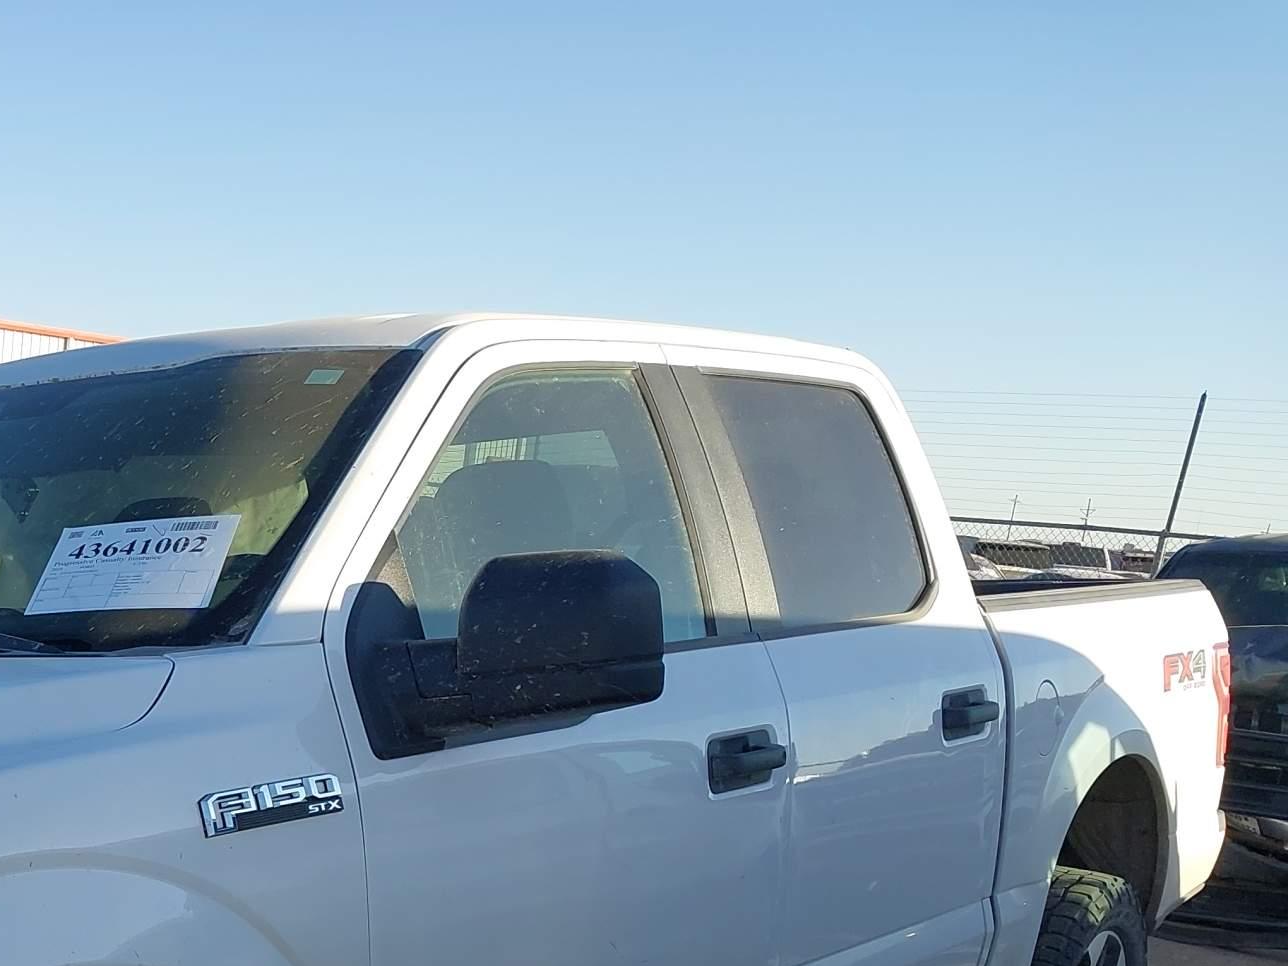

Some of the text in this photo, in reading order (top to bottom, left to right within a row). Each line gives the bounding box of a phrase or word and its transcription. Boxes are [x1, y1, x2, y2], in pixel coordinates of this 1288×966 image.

[68, 536, 208, 559] 43641002
[1163, 649, 1206, 692] FX4
[308, 799, 342, 814] STX
